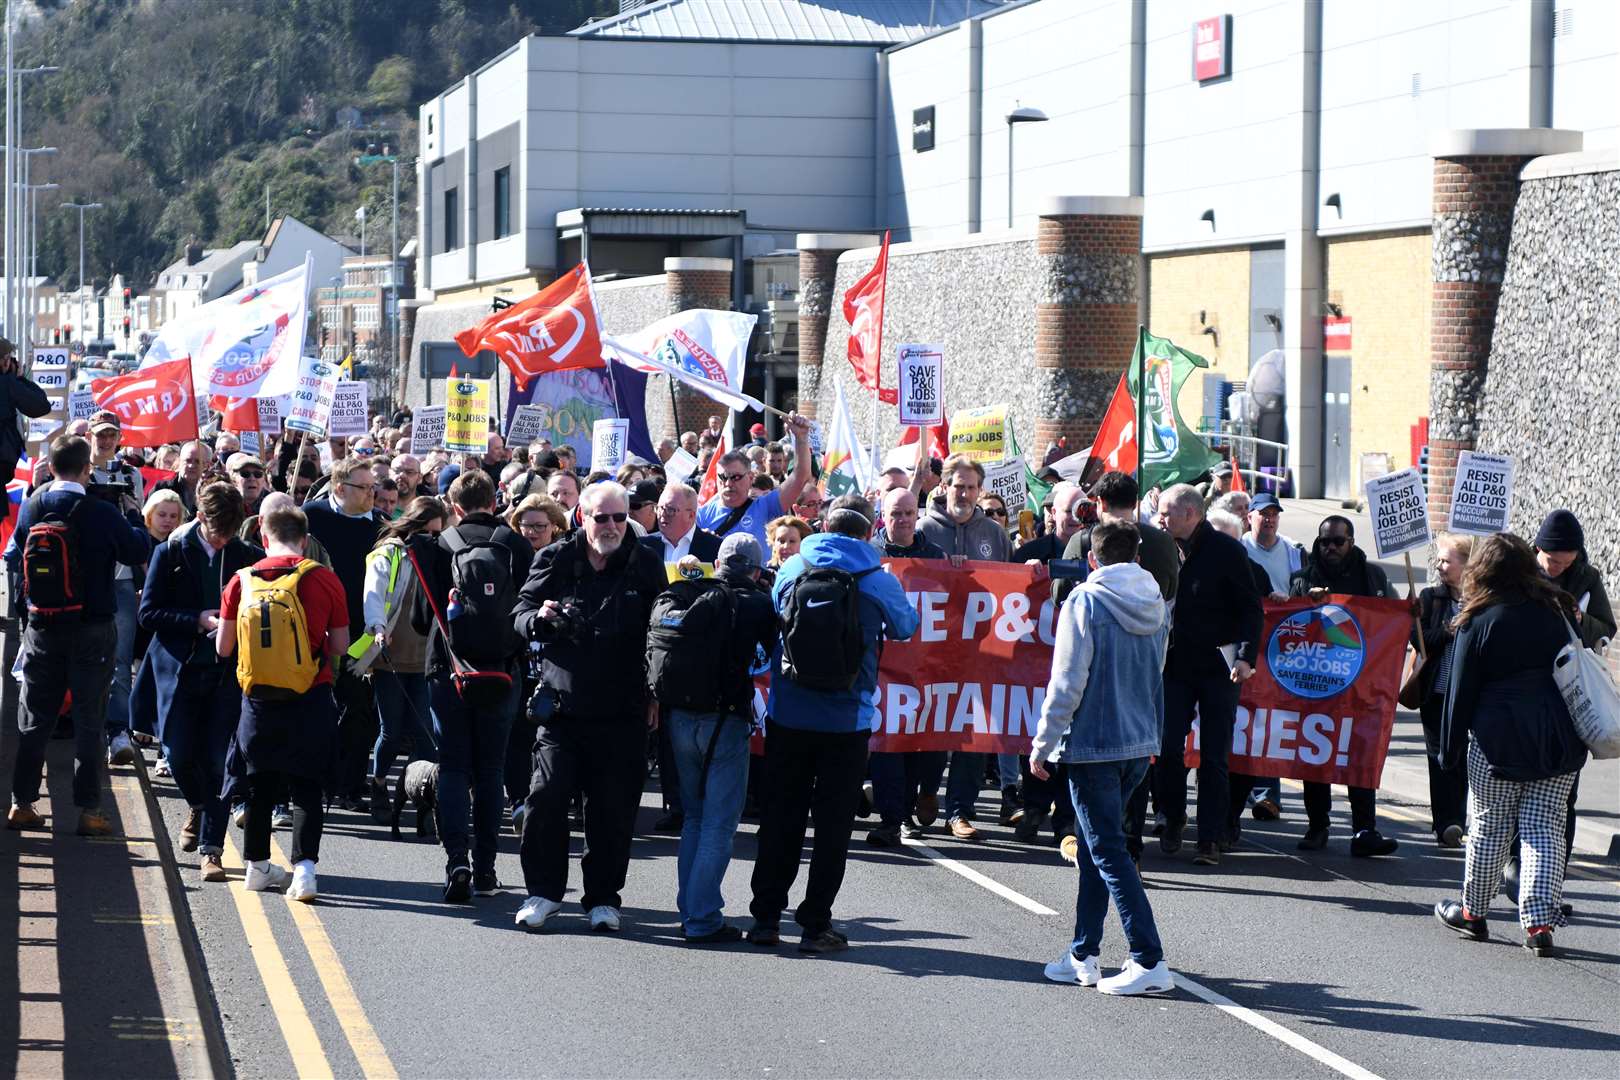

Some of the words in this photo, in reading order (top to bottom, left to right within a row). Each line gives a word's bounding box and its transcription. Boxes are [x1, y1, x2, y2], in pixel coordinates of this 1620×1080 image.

[36, 354, 66, 364] P&O
[909, 365, 936, 377] SAVE
[38, 375, 62, 384] can
[300, 377, 321, 388] STOP
[322, 382, 334, 393] THE
[911, 377, 934, 389] P&O
[296, 390, 313, 401] P&O
[335, 393, 360, 401] RESIST
[909, 388, 936, 401] JOBS
[449, 399, 468, 408] STOP
[259, 407, 278, 415] CUTS
[292, 407, 317, 420] CARVE
[331, 408, 345, 416] JOB
[345, 408, 365, 416] CUTS
[420, 416, 444, 425] RESIST
[447, 412, 461, 421] P&O
[463, 414, 486, 423] JOBS
[981, 416, 1000, 426] THE
[417, 424, 429, 432] ALL
[430, 423, 446, 431] P&O
[415, 432, 428, 440] JOB
[429, 431, 444, 439] CUT
[601, 432, 619, 441] SAVE
[952, 433, 973, 443] P&O
[976, 432, 1003, 442] JOBS
[992, 472, 1019, 488] RESIST
[1467, 469, 1505, 484] RESIST
[1006, 483, 1021, 496] P&O
[1461, 480, 1480, 493] ALL
[1482, 483, 1506, 496] P&O
[1006, 494, 1025, 507] CUTS
[1380, 485, 1415, 504] RESIST
[1456, 492, 1477, 504] JOB
[1479, 495, 1506, 509] CUTS
[1378, 504, 1398, 517] ALL
[1399, 496, 1420, 512] P&O
[1462, 506, 1489, 516] OCCUPY
[1378, 515, 1397, 529] JOB
[1400, 506, 1424, 523] CUTS
[1461, 514, 1503, 526] NATIONALISE
[1386, 524, 1412, 537] OCCUPY
[1387, 527, 1427, 545] NATIONALISE
[1285, 641, 1327, 659] SAVE
[1275, 654, 1308, 670] P&O
[1309, 658, 1351, 676] JOBS
[1278, 669, 1301, 681] SAVE
[1301, 672, 1346, 687] BRITAIN'S
[1294, 681, 1329, 692] FERRIES
[1232, 705, 1353, 767] RIES!
